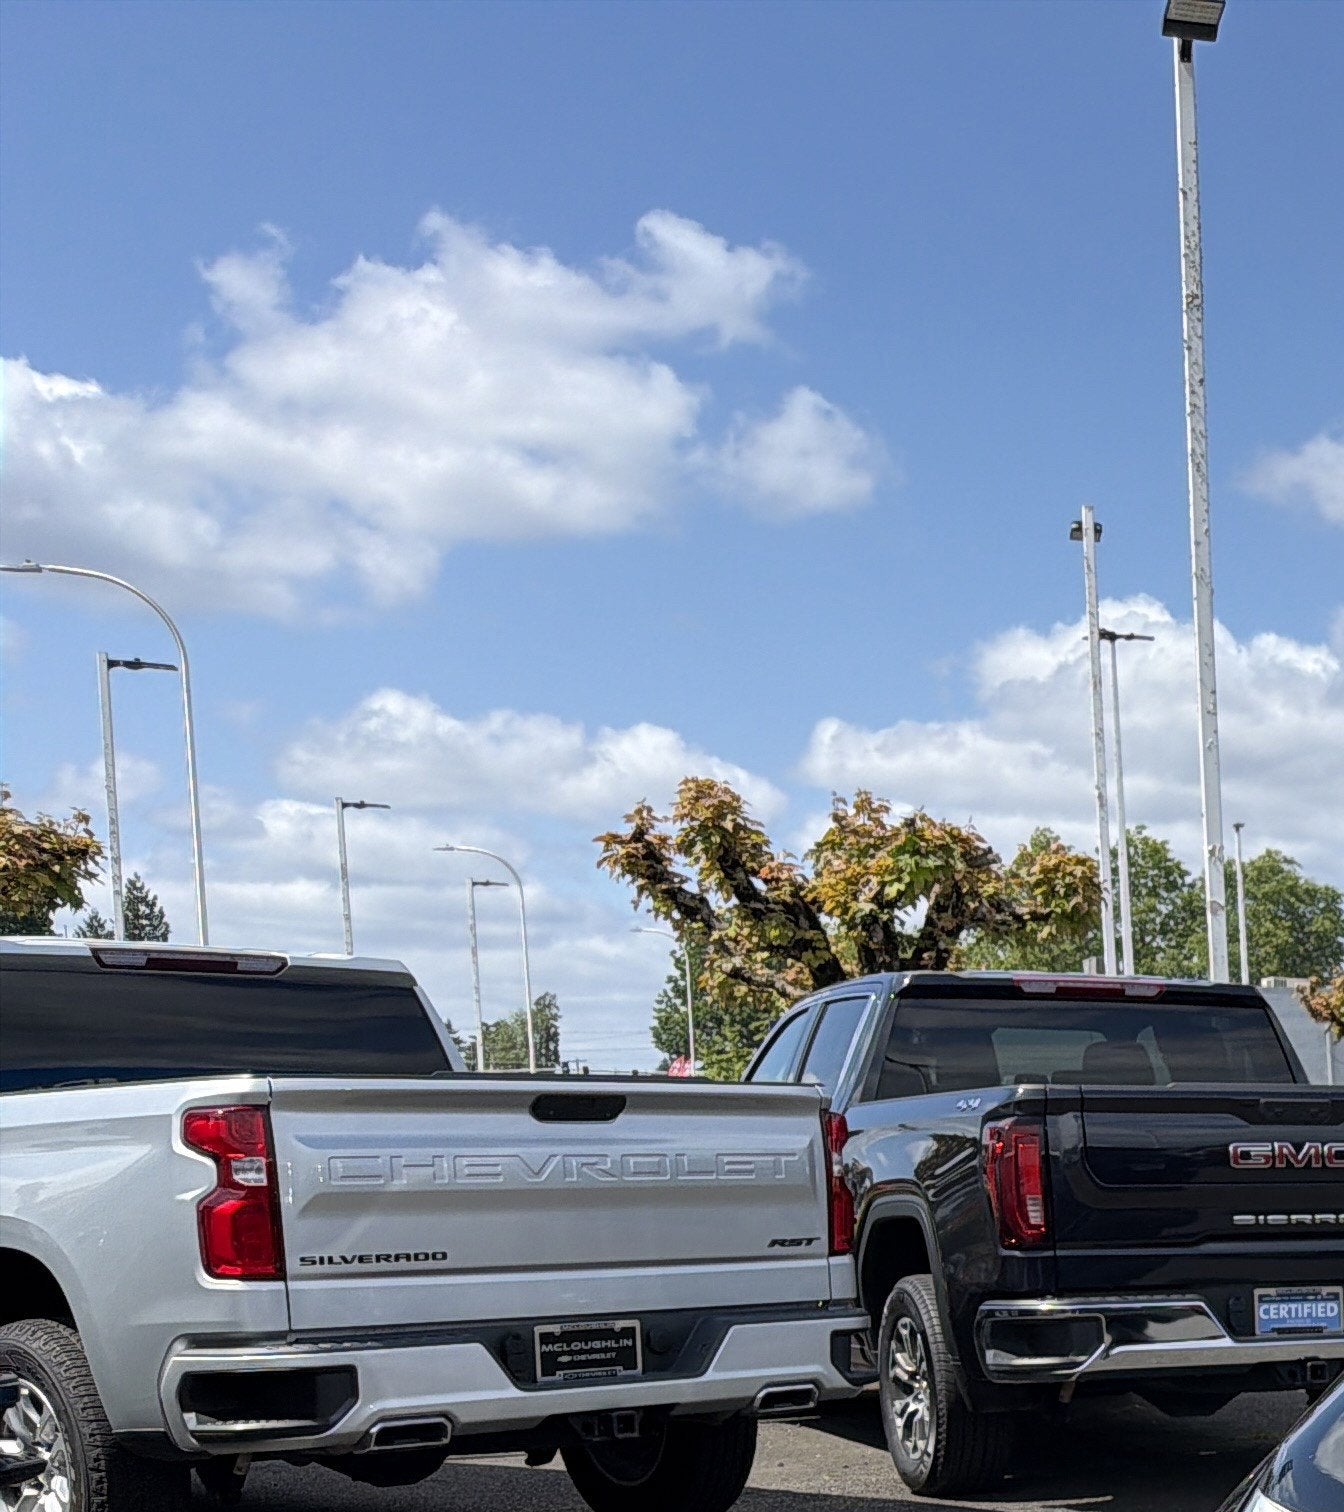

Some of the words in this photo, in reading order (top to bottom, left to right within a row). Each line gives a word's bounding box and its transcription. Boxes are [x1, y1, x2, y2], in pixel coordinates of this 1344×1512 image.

[327, 1152, 800, 1186] CHEVROLET
[767, 1236, 822, 1249] RST
[299, 1251, 448, 1268] SILVERADO
[1259, 1303, 1339, 1320] CERTIFIED
[541, 1338, 634, 1353] MCLOUGHLIN
